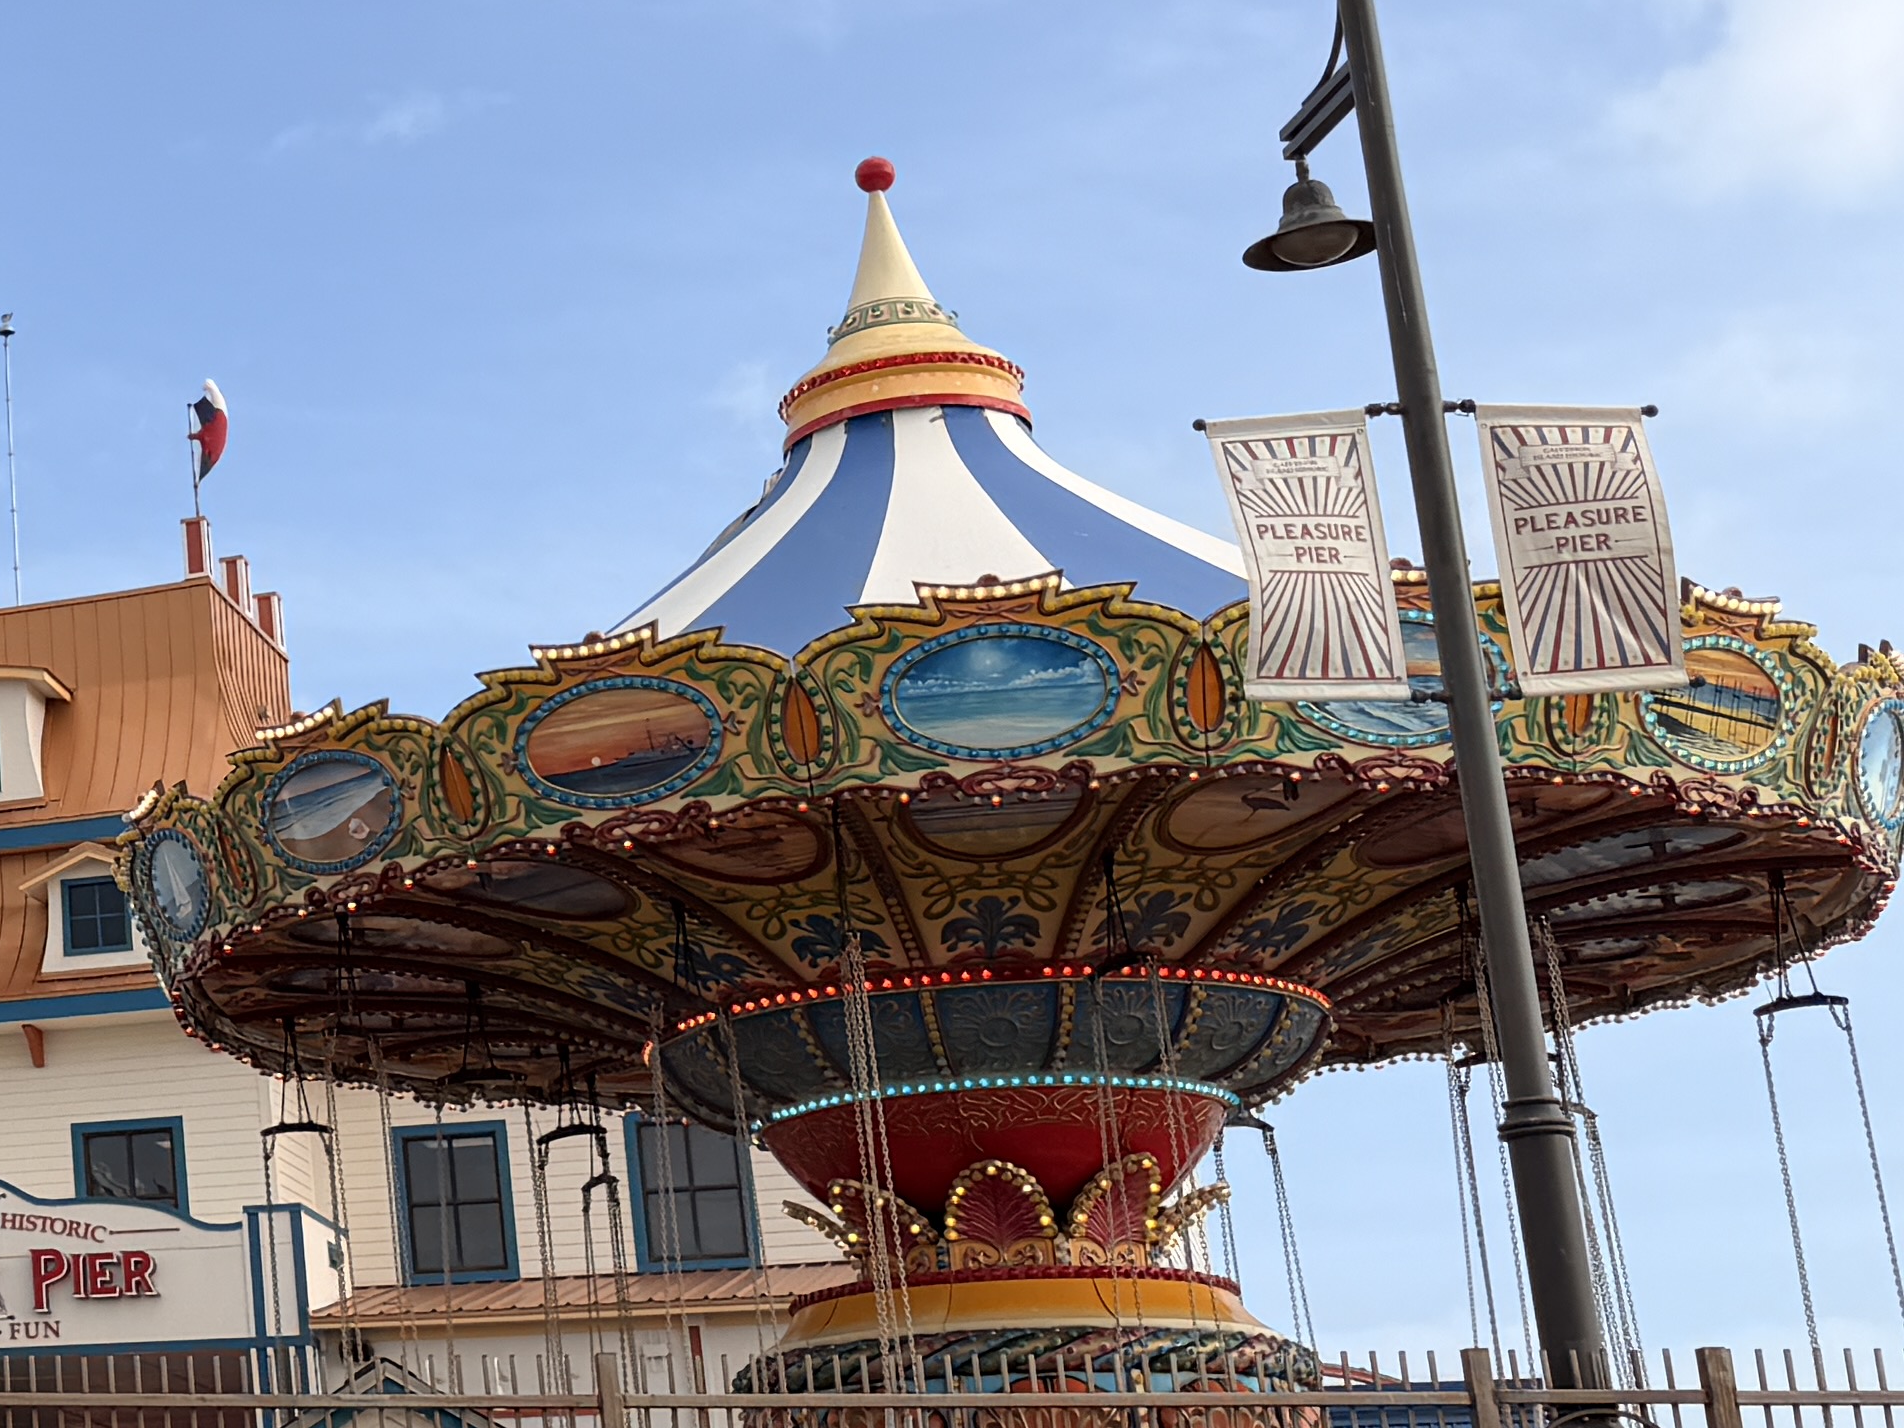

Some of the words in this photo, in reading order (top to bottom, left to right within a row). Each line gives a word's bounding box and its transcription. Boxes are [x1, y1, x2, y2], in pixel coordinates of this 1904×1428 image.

[1514, 506, 1648, 535] PLEASURE
[1256, 523, 1368, 543] PLEASURE
[1556, 533, 1613, 554] PIER
[1294, 546, 1343, 565] PIER
[1, 1212, 108, 1243] HISTORIC
[30, 1248, 160, 1313] PIER
[9, 1320, 61, 1341] FUN
